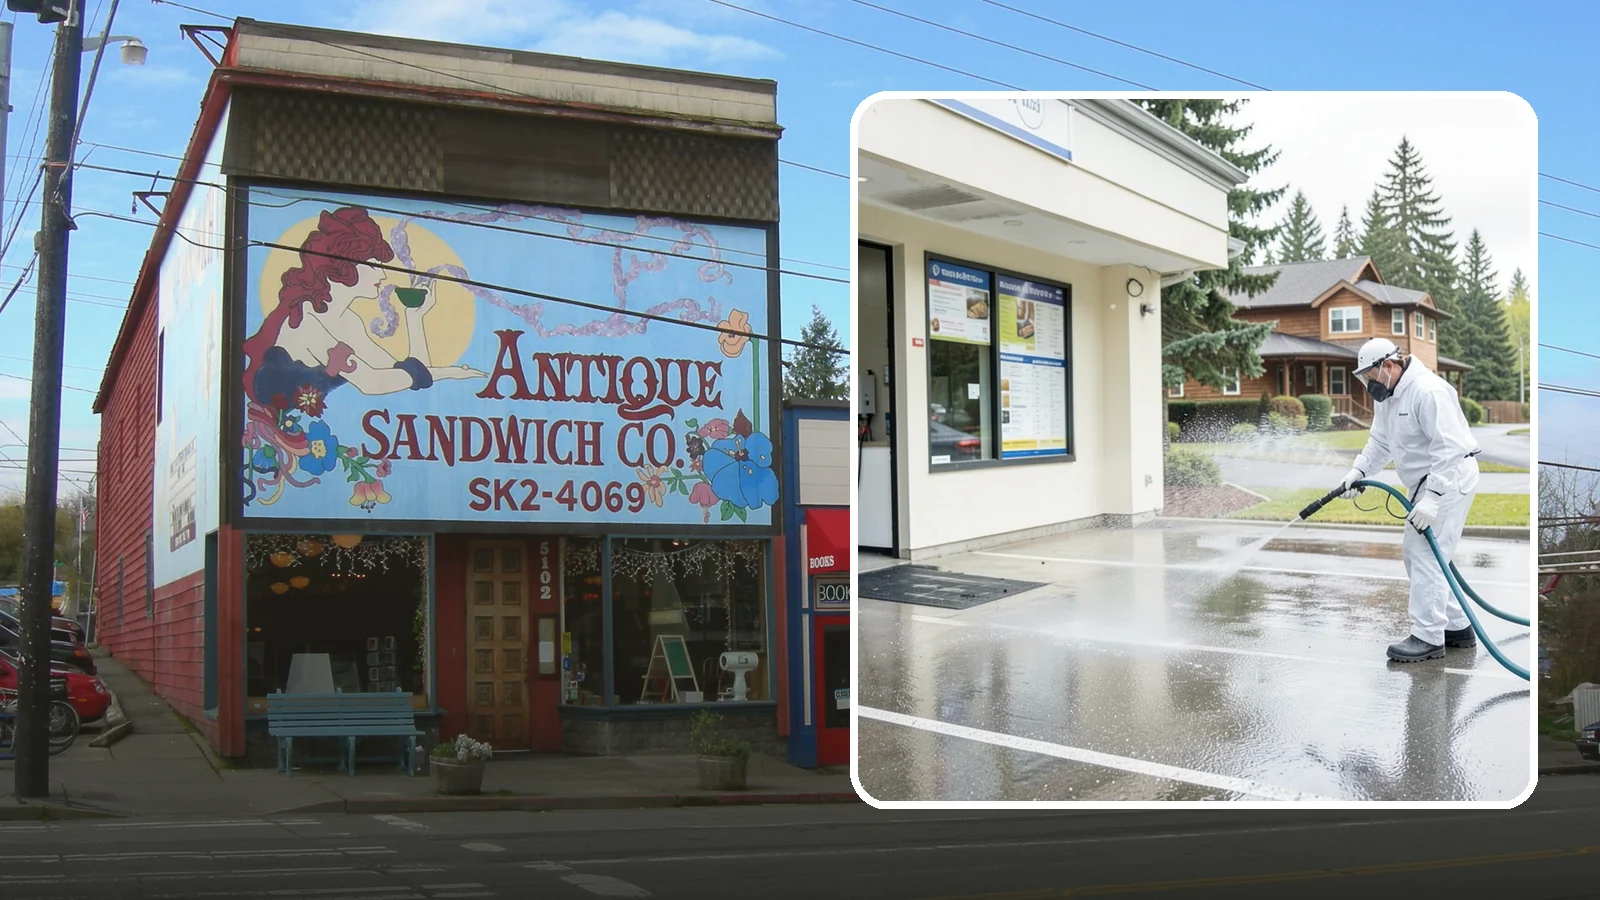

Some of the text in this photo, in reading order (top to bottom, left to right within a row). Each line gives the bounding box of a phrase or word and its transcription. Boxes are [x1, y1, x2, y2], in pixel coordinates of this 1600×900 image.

[475, 329, 723, 420] ANTIQUE
[361, 408, 685, 469] SANDWICH CO.
[468, 478, 645, 513] SK2-4069
[540, 542, 551, 599] 5102
[809, 555, 835, 569] BOOKS
